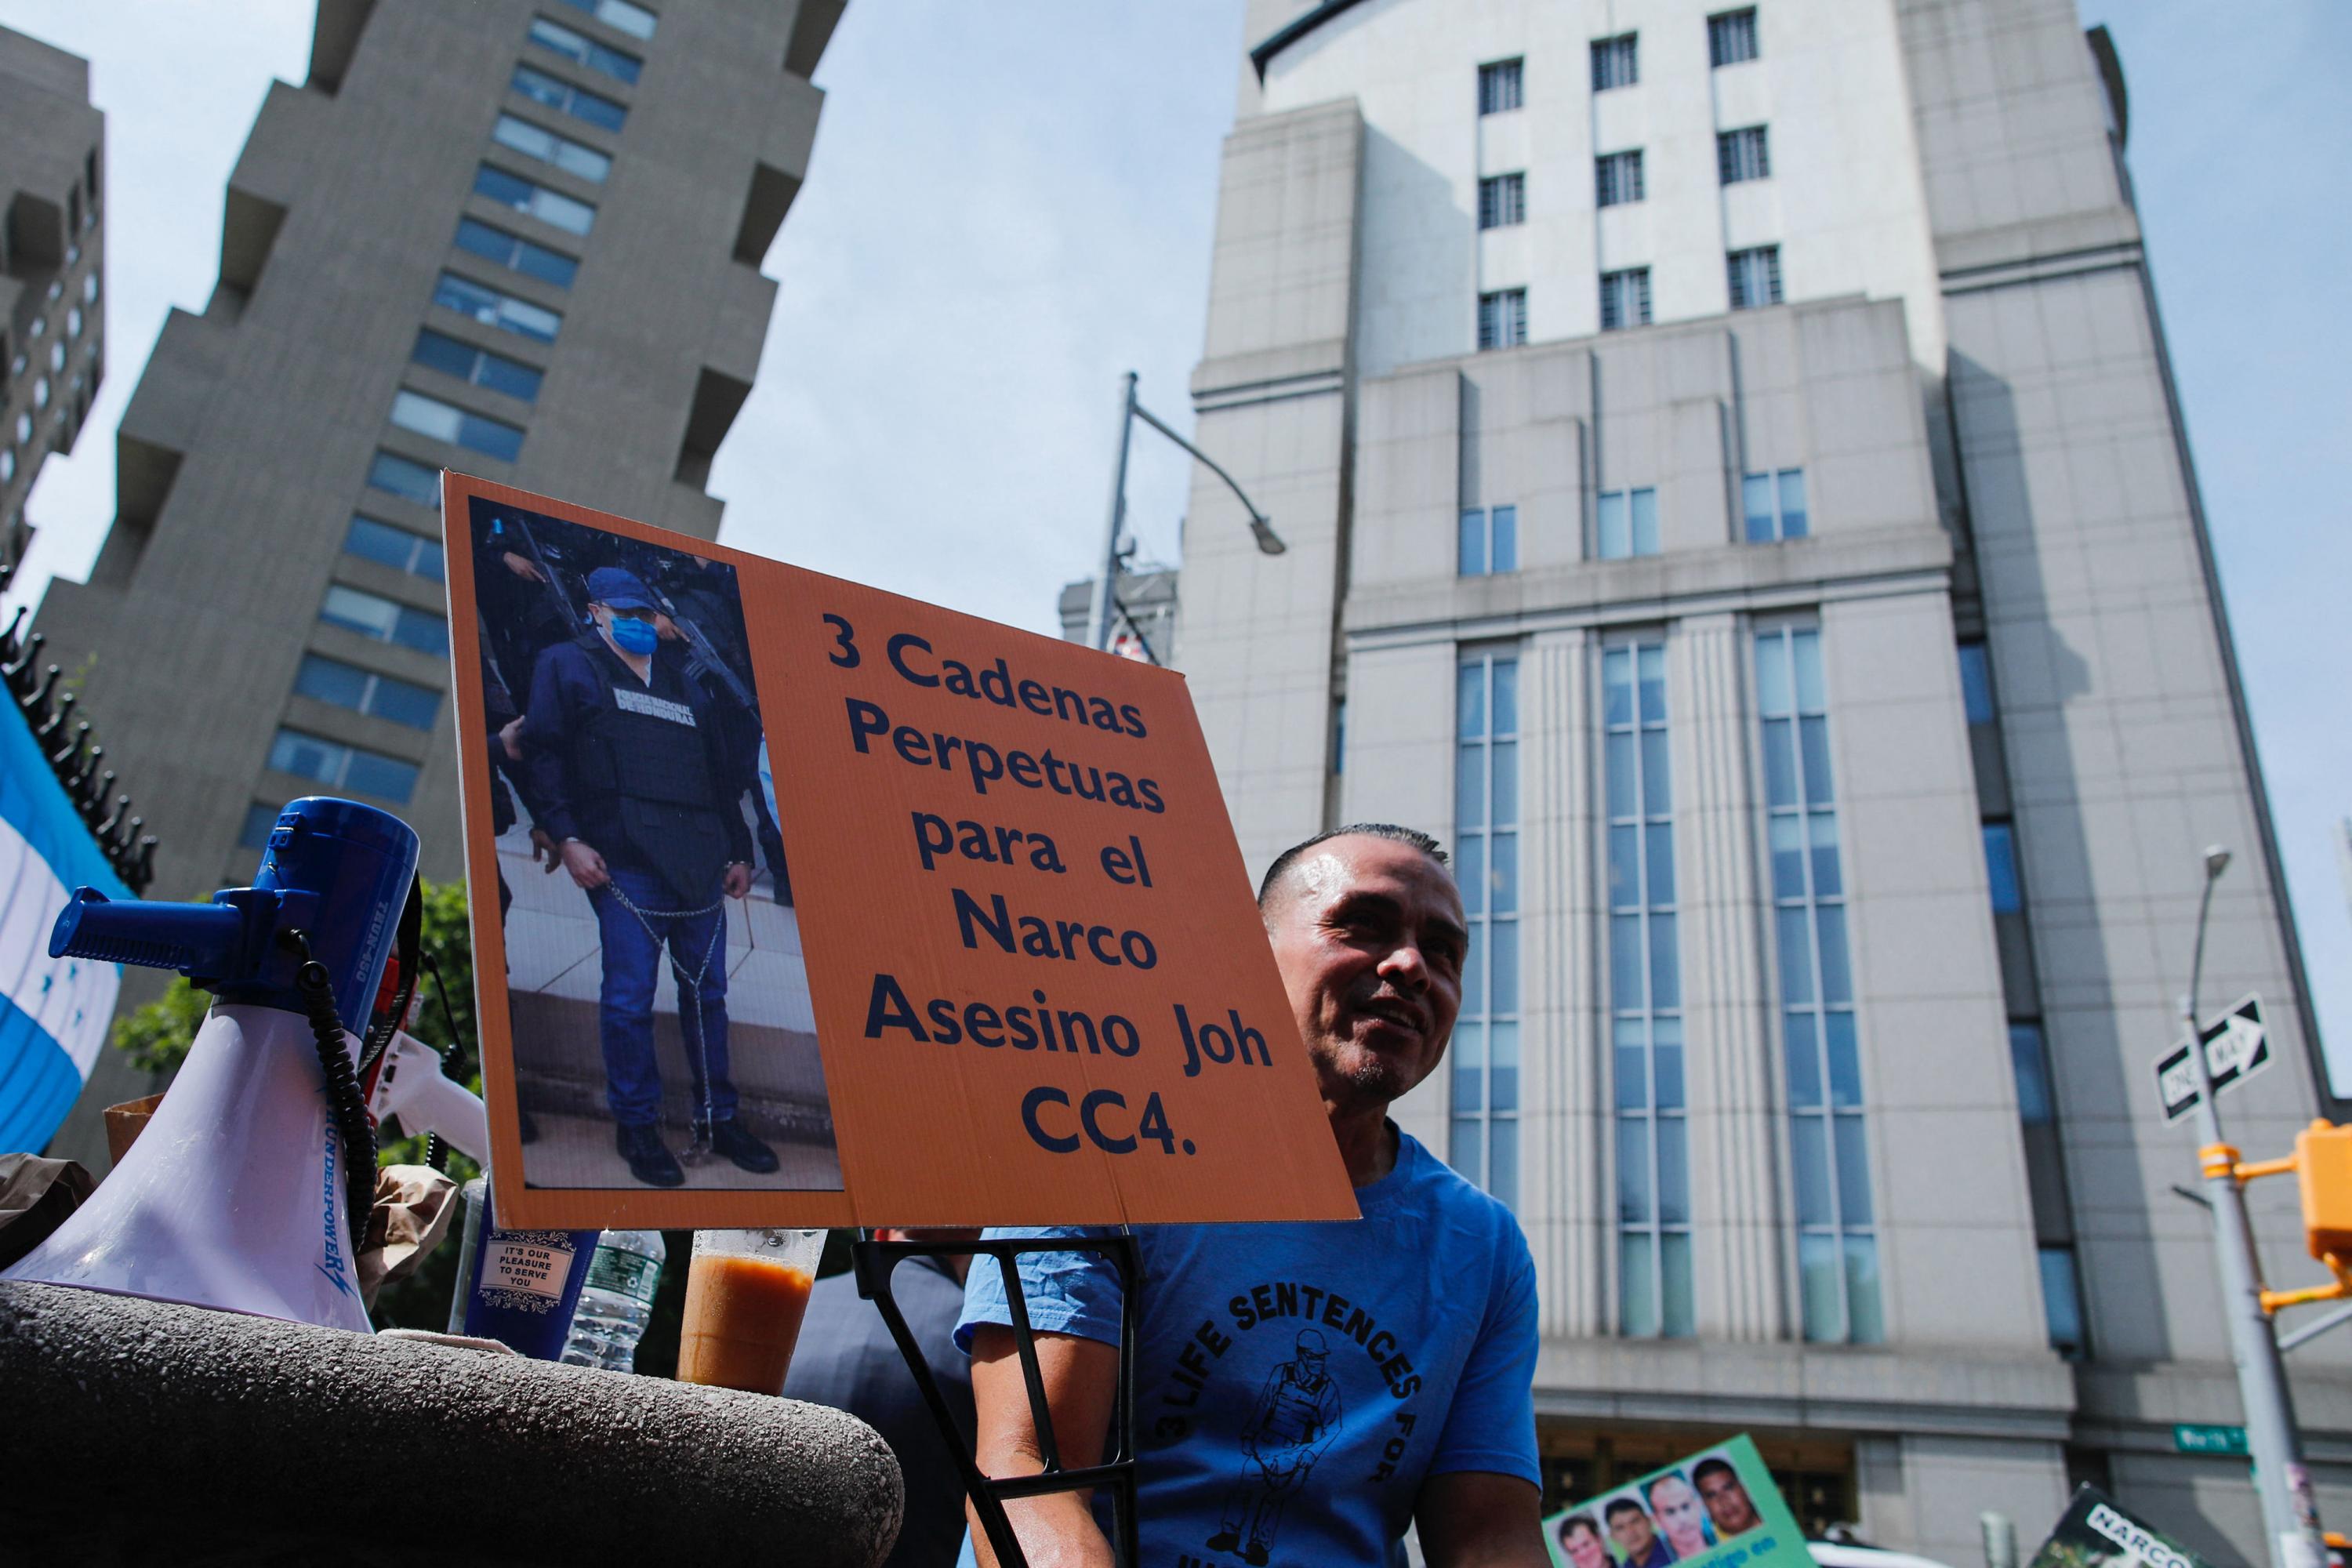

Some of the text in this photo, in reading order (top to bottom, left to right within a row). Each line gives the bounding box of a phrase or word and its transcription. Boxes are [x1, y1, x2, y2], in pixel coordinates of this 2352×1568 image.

[823, 614, 1147, 738] 3 Cadenas
[845, 698, 1164, 813] Perpetuas
[912, 811, 1152, 887] para el
[952, 888, 1157, 969] Narco
[865, 974, 1272, 1077] Asesino Joh
[1022, 1087, 1196, 1155] CC4.
[499, 1256, 552, 1271] PLEASURE
[505, 1247, 550, 1260] IT'S OUR
[510, 1276, 531, 1287] YOU
[514, 1268, 547, 1279] SERVE
[1155, 1283, 1421, 1482] 3 LIFE SENTENCES FOR
